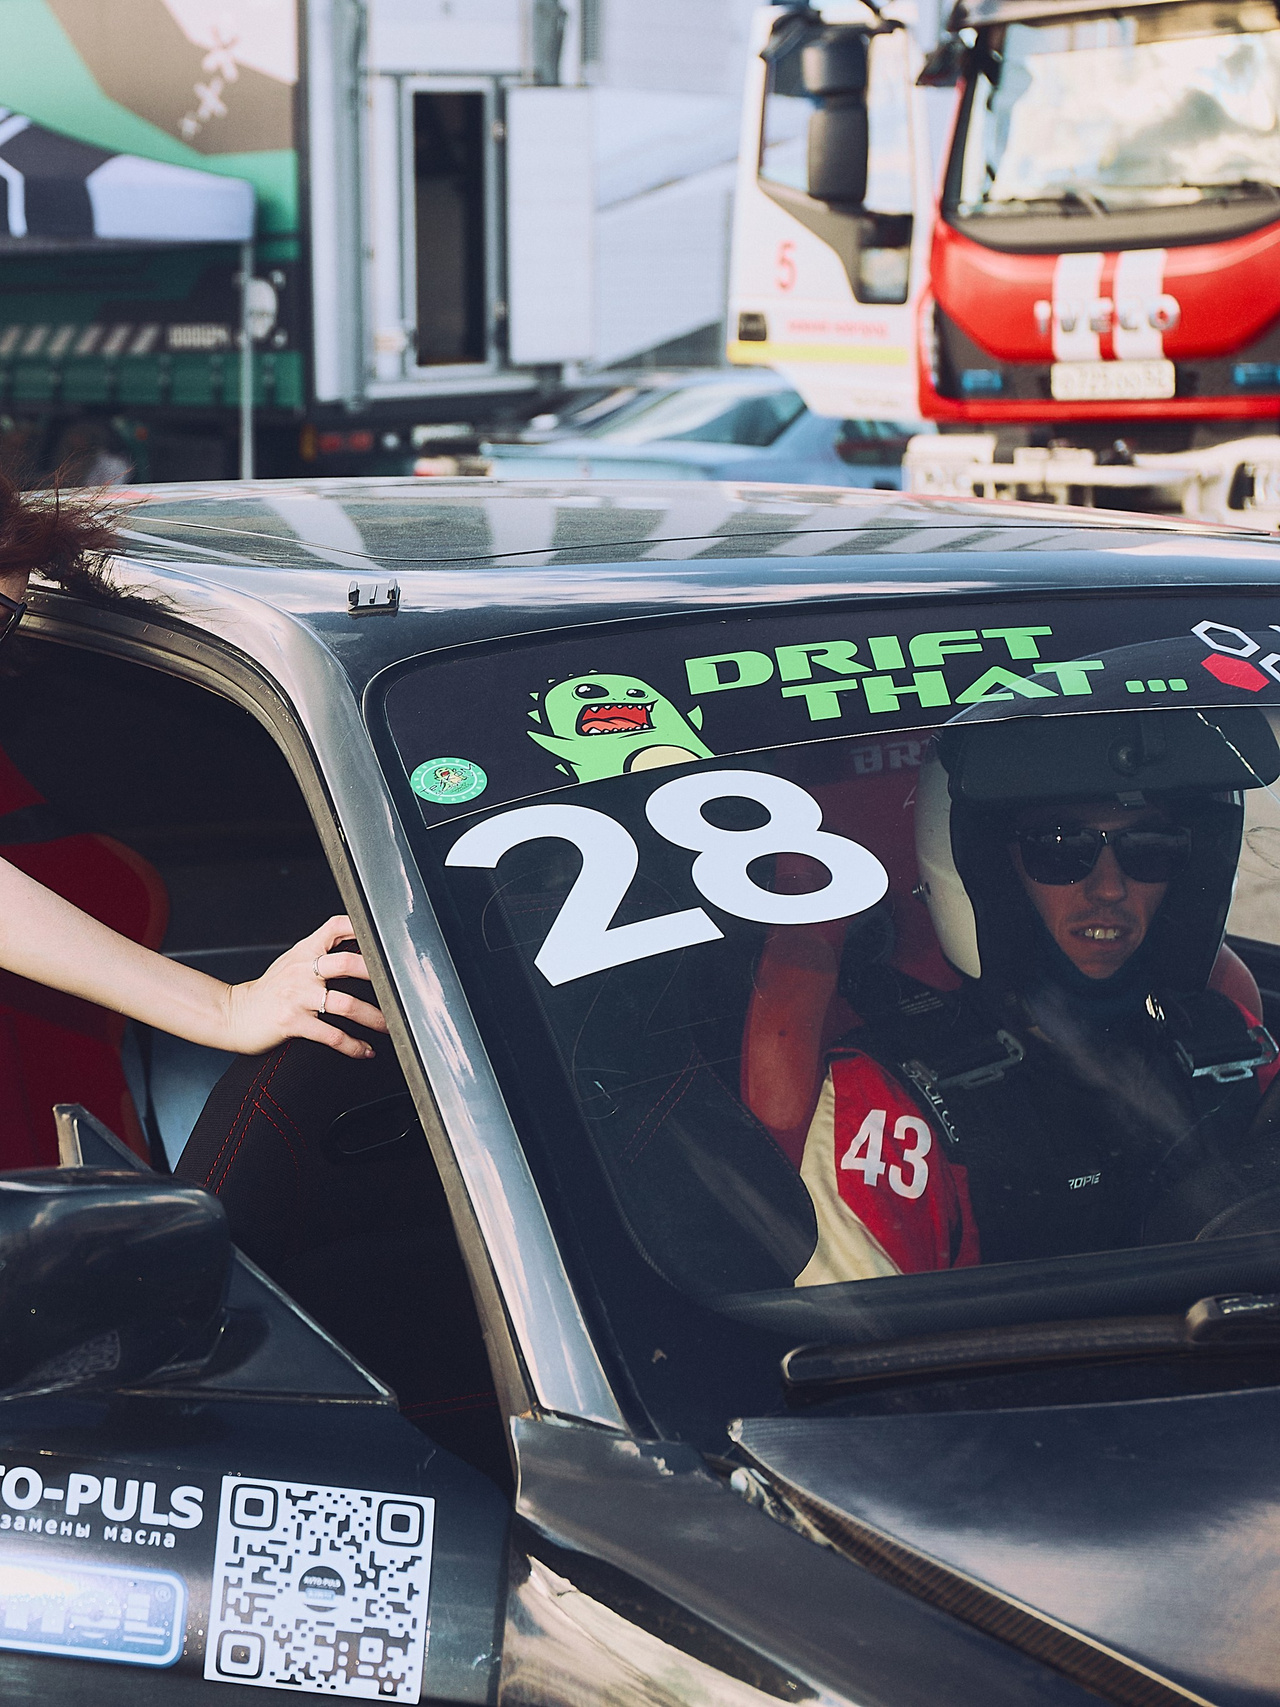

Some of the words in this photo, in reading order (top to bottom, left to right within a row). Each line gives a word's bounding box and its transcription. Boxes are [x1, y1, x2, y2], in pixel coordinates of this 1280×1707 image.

[776, 240, 798, 291] 5
[686, 626, 1053, 695] DRIFT
[780, 659, 1105, 721] THAT
[445, 770, 889, 987] 28
[840, 1109, 932, 1199] 43
[0, 1513, 91, 1538] замены
[104, 1525, 176, 1549] масла
